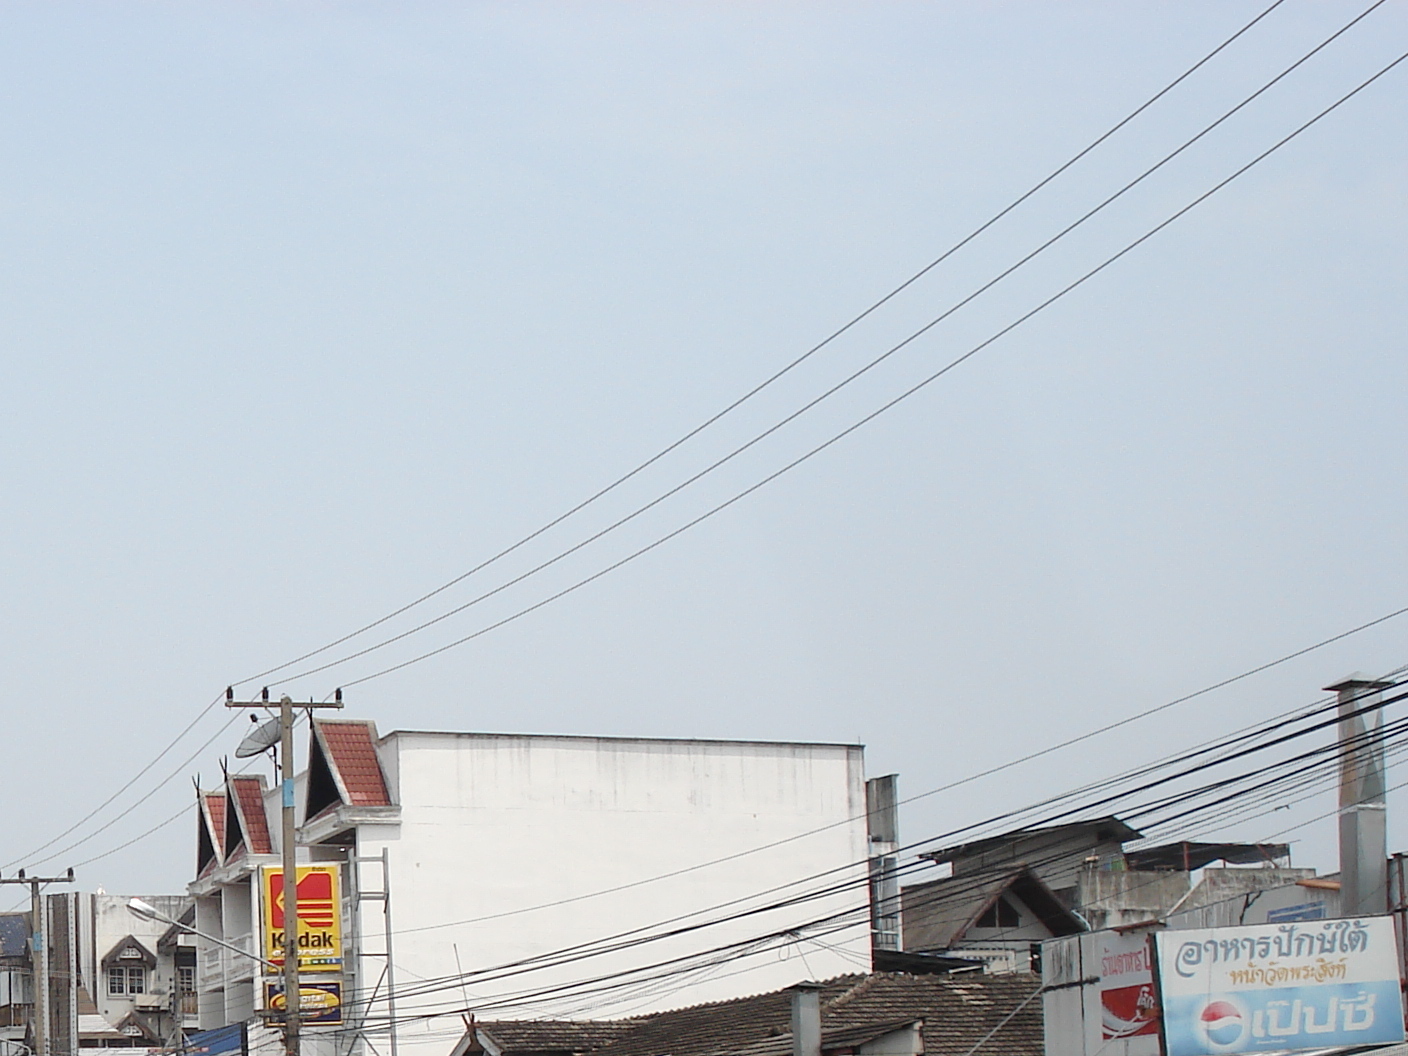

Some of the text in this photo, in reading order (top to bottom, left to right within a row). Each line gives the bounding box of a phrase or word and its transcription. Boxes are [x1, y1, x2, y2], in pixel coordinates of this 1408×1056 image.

[272, 931, 334, 948] Kdak
[273, 948, 334, 957] epress
[1175, 920, 1369, 978] อาหารปักษ์ใต้
[1251, 991, 1378, 1038] เป๊ปซี่
